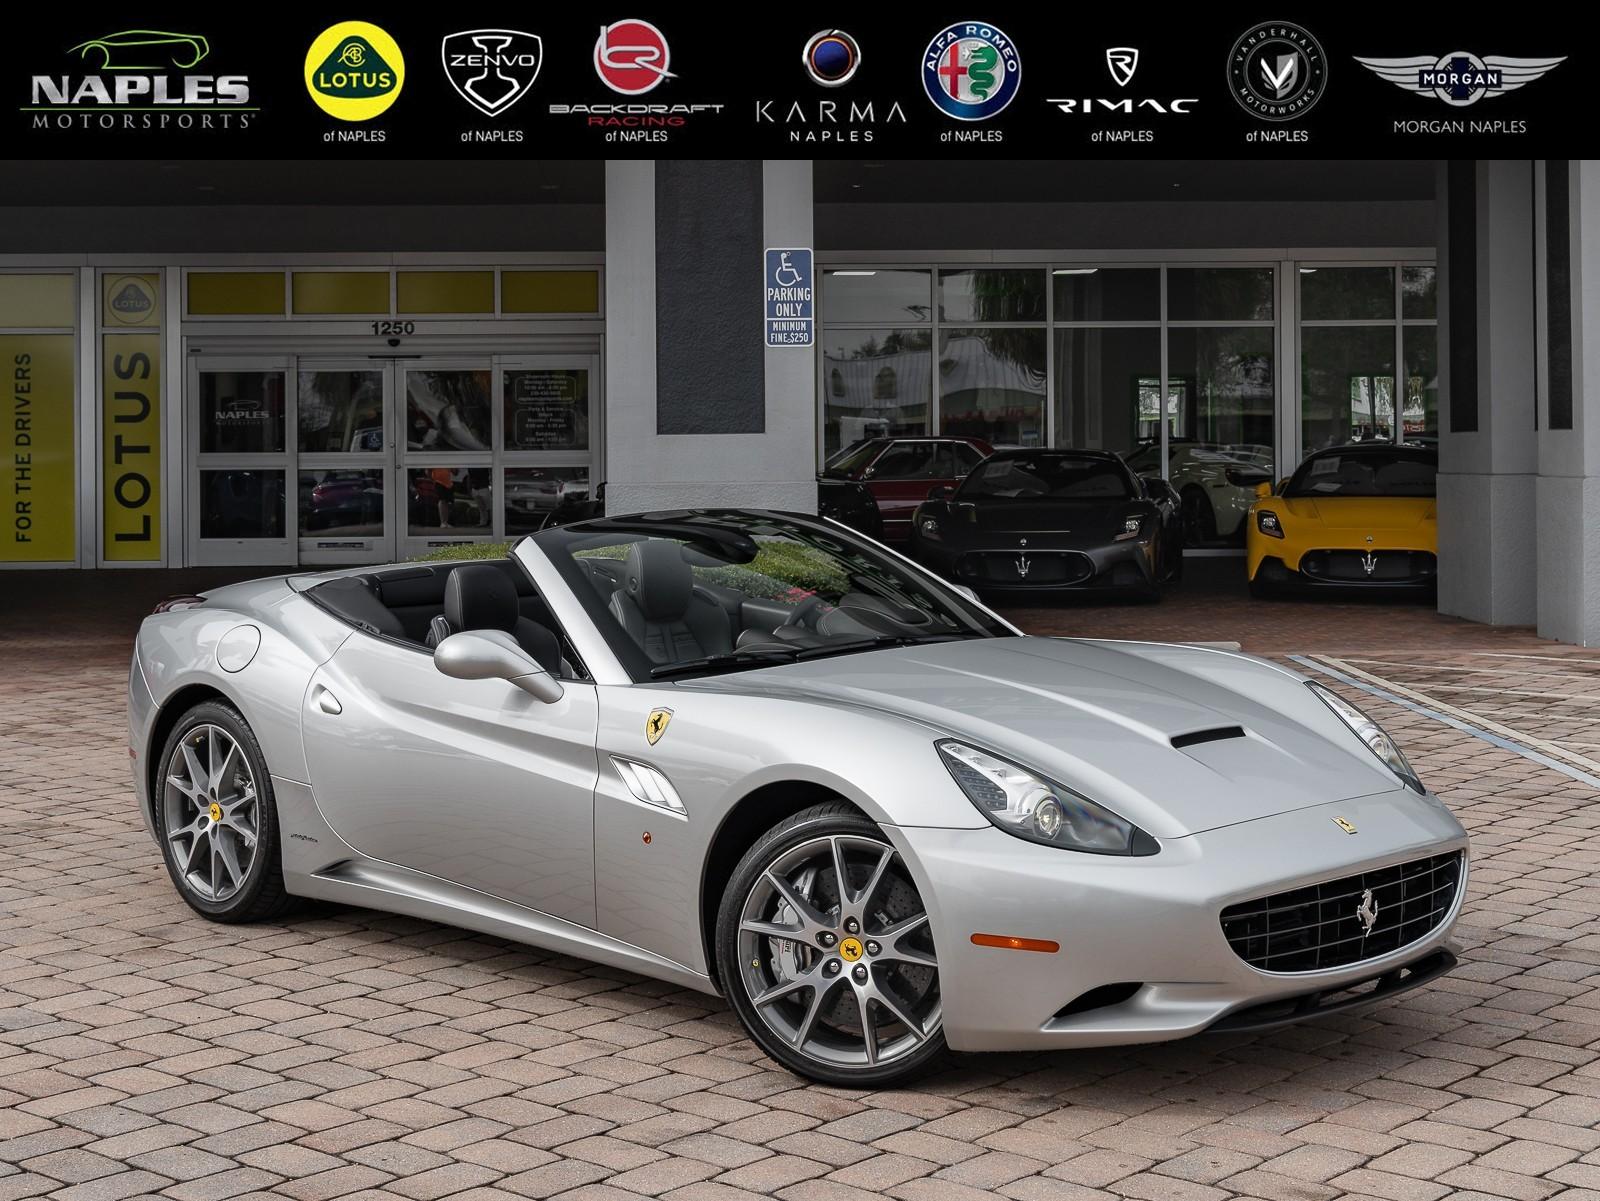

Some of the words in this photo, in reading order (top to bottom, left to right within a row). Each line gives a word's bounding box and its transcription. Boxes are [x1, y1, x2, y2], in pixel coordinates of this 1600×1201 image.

[767, 287, 811, 301] PARKING
[114, 300, 149, 309] LOTUS
[776, 303, 803, 317] ONLY
[371, 321, 416, 336] 1250
[772, 321, 807, 331] MINIMUM
[770, 333, 788, 343] FINE
[790, 332, 809, 343] $250
[14, 353, 31, 446] DRIVERS
[215, 410, 270, 420] NAPLES
[113, 352, 152, 542] LOTUS
[15, 453, 31, 494] THE
[15, 501, 32, 542] FOR
